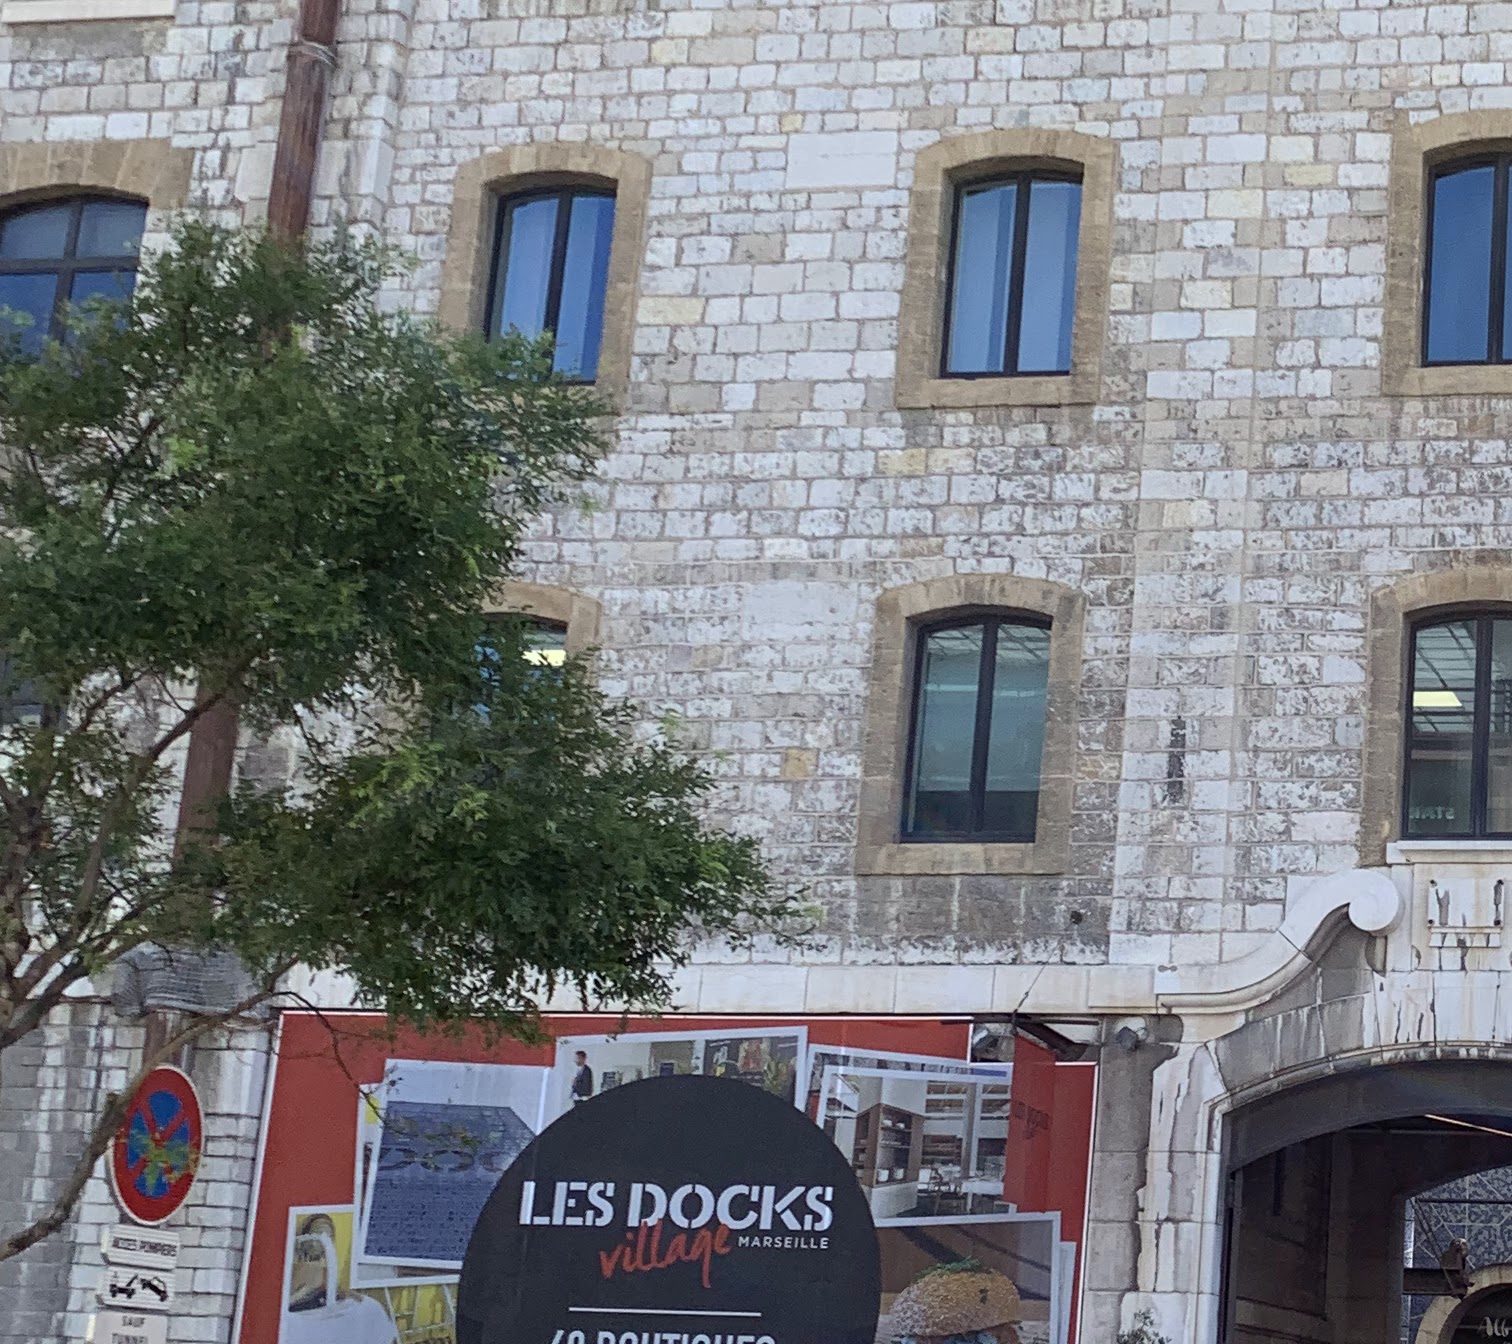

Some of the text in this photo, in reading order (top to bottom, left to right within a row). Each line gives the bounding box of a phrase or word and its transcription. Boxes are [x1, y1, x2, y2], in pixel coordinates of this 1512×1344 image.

[519, 1180, 834, 1233] LES DOCKS
[600, 1220, 733, 1288] village
[738, 1236, 830, 1250] MARSEILLE
